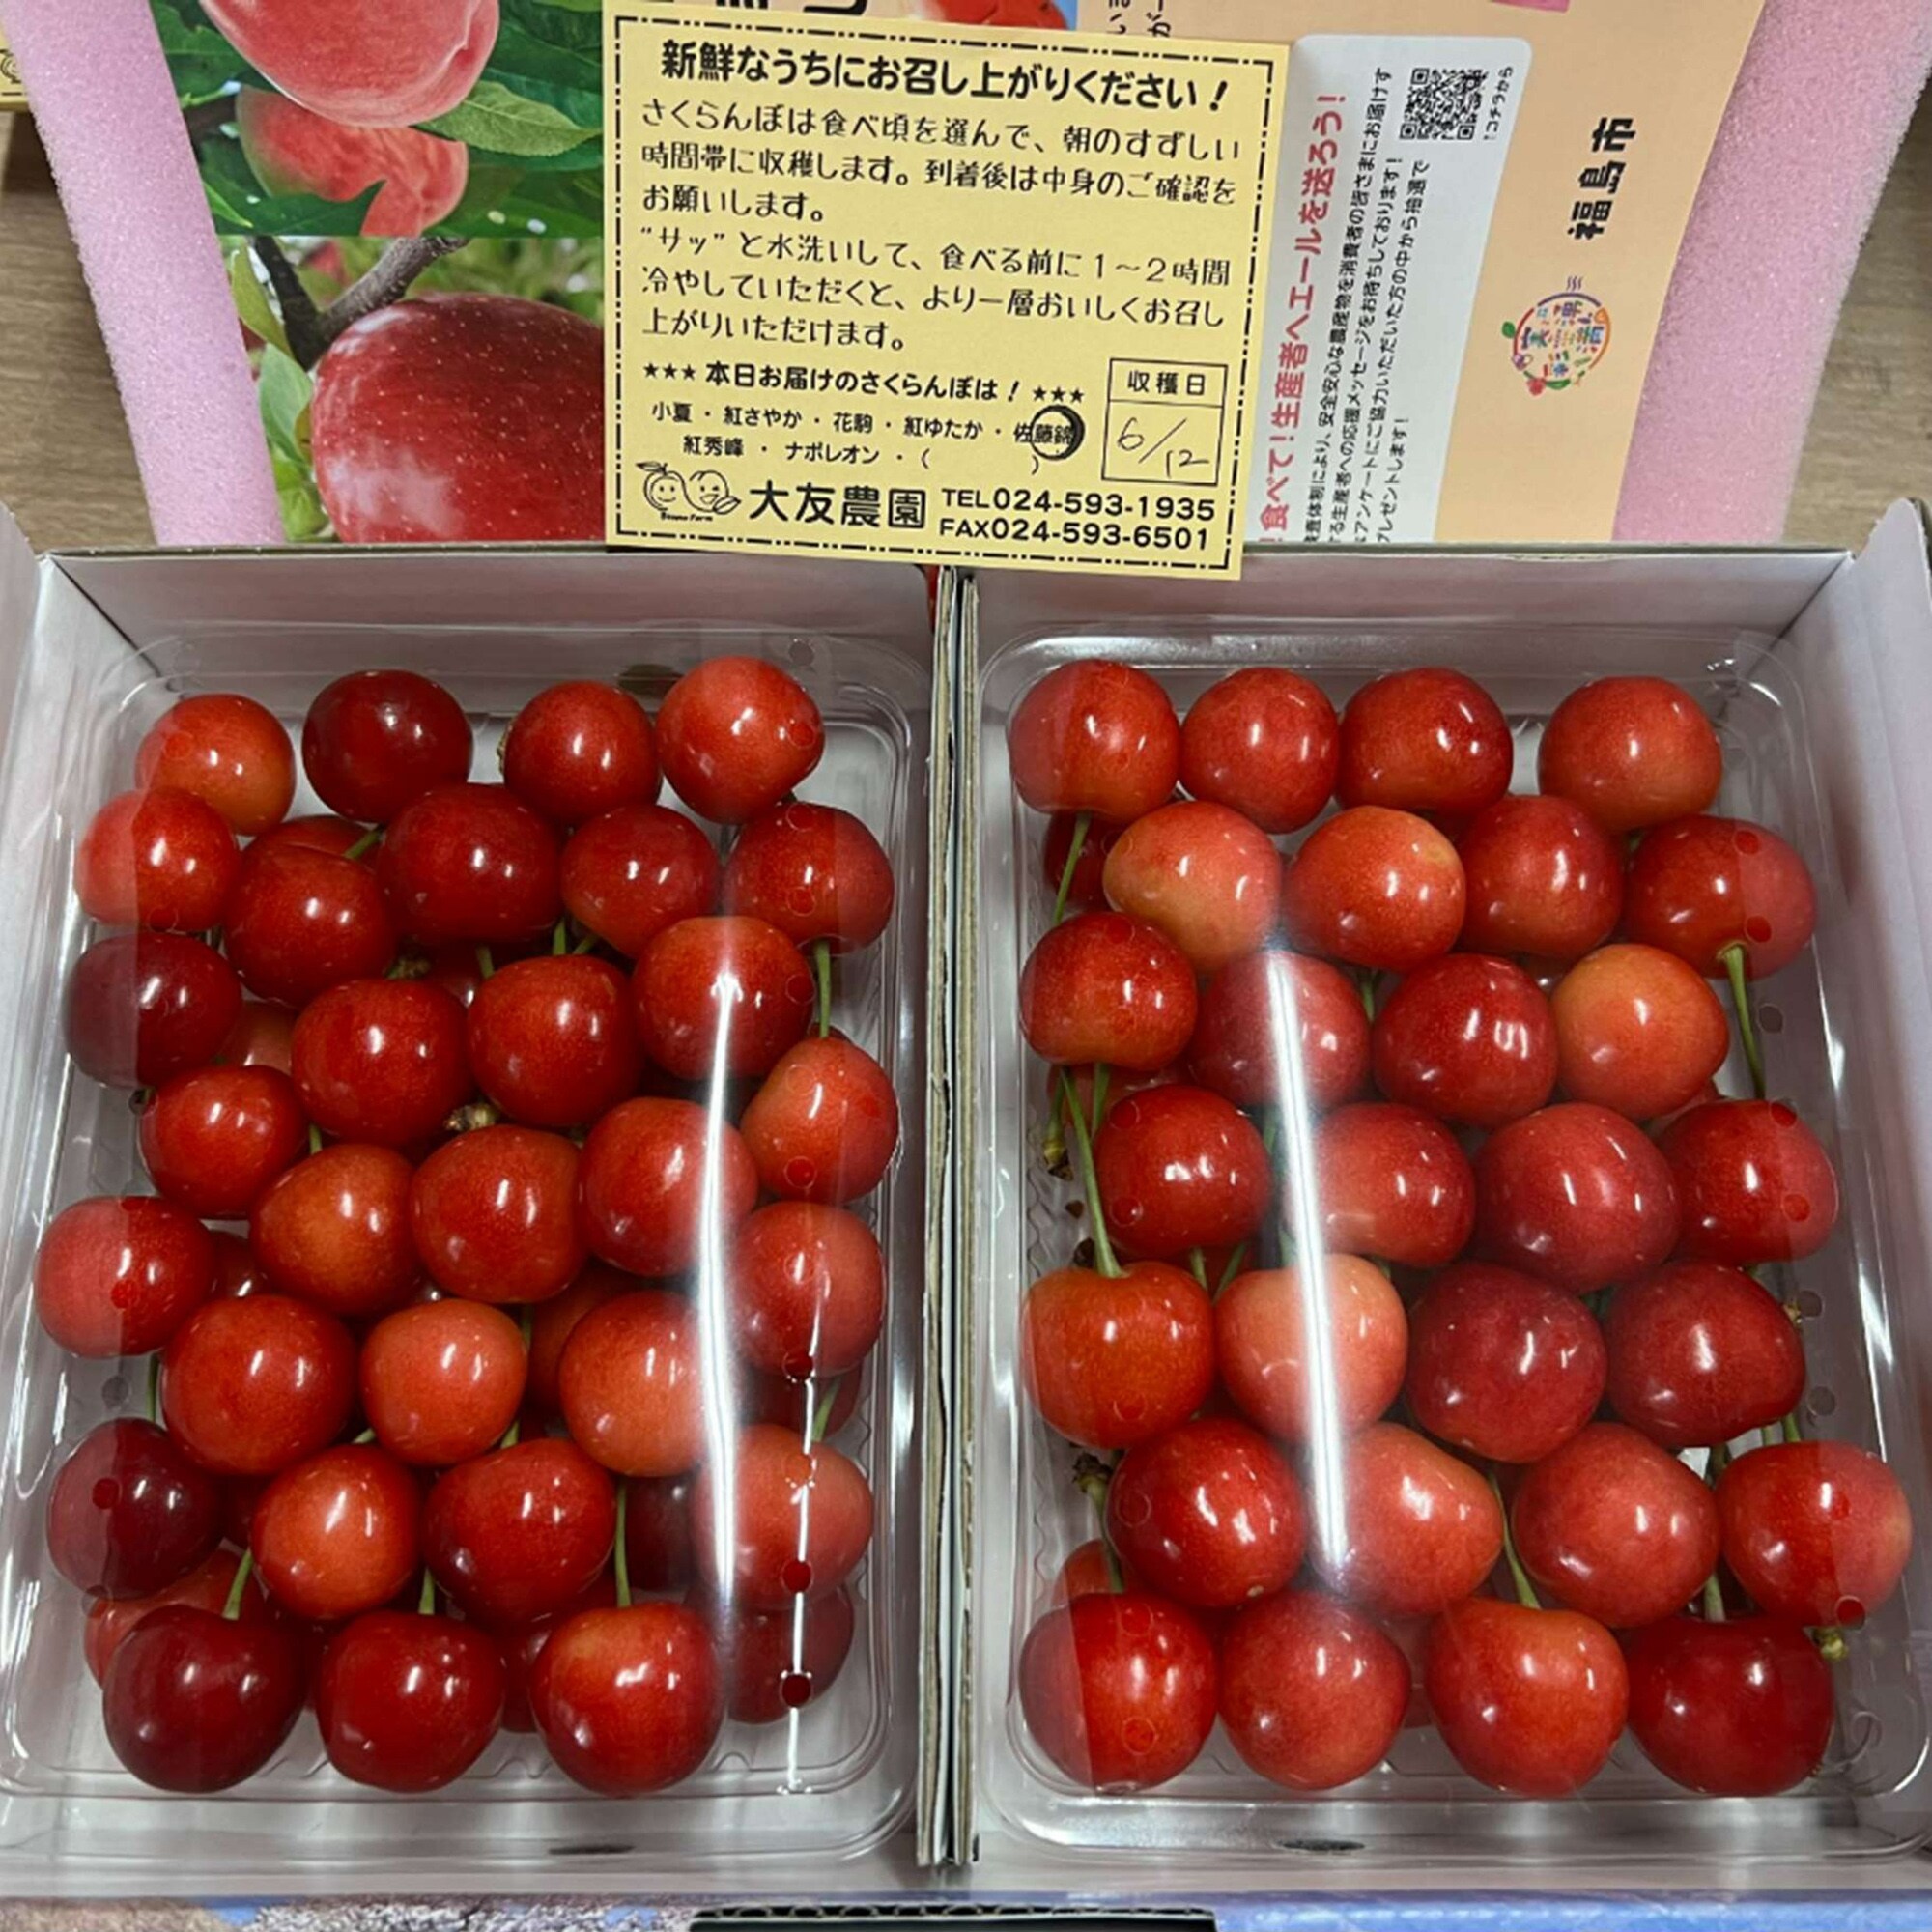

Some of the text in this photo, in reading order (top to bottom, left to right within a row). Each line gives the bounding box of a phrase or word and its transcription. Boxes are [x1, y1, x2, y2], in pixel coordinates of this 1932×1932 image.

[662, 40, 1229, 112] 新鮮なうちにお召し上がりください！
[642, 98, 1239, 161] さくらんぼは食べ頃を選んで、朝のすずしい
[1567, 117, 1636, 241] 福島市
[642, 185, 823, 222] お願いします。
[641, 266, 1224, 327] 冷やしていただくと、より一層おいしくお召し
[641, 307, 904, 351] 上がりいただけます。
[705, 360, 1020, 403] 本日お届けのさくらんぼは！
[1126, 370, 1207, 396] 収穫日
[652, 401, 693, 423] 小夏
[724, 406, 802, 428] 紅さやか
[902, 416, 983, 440] 紅ゆたか
[784, 441, 880, 465] ナポレオン
[749, 480, 927, 529] 大友農園
[941, 487, 1216, 522] TEL024-593-1935
[939, 518, 1208, 551] FAX024-593-6501
